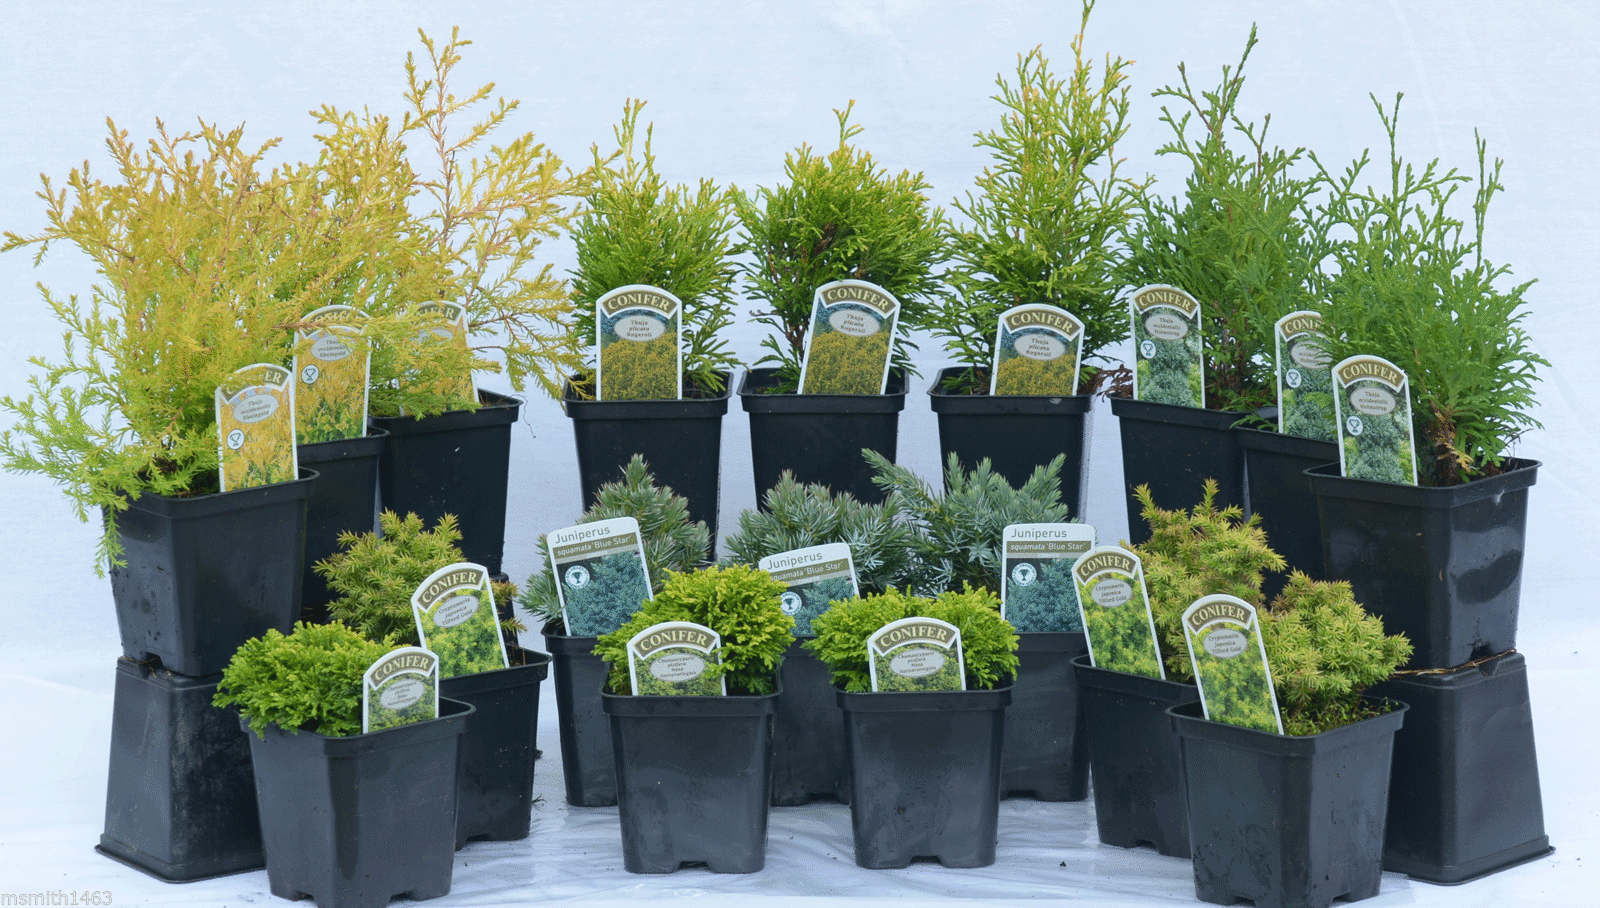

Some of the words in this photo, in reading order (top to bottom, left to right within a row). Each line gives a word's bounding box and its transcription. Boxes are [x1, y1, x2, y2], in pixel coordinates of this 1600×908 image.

[608, 293, 670, 311] CONIFER
[827, 287, 889, 311] CONIFER
[1139, 291, 1191, 311] CONIFER
[846, 313, 864, 322] Thuja
[1011, 312, 1073, 333] CONIFER
[1031, 338, 1049, 346] Thuja
[1342, 363, 1398, 384] CONIFER
[555, 526, 611, 544] Juniperus
[1010, 528, 1068, 541] Juniperus
[557, 543, 592, 557] squamata
[1010, 543, 1046, 552] squamata
[767, 552, 823, 571] Juniperus
[1080, 555, 1131, 577] CONIFER
[422, 571, 477, 603] CONIFER
[1192, 604, 1245, 625] CONIFER
[640, 630, 708, 651] CONIFER
[880, 625, 948, 647] CONIFER
[375, 655, 429, 680] CONIFER
